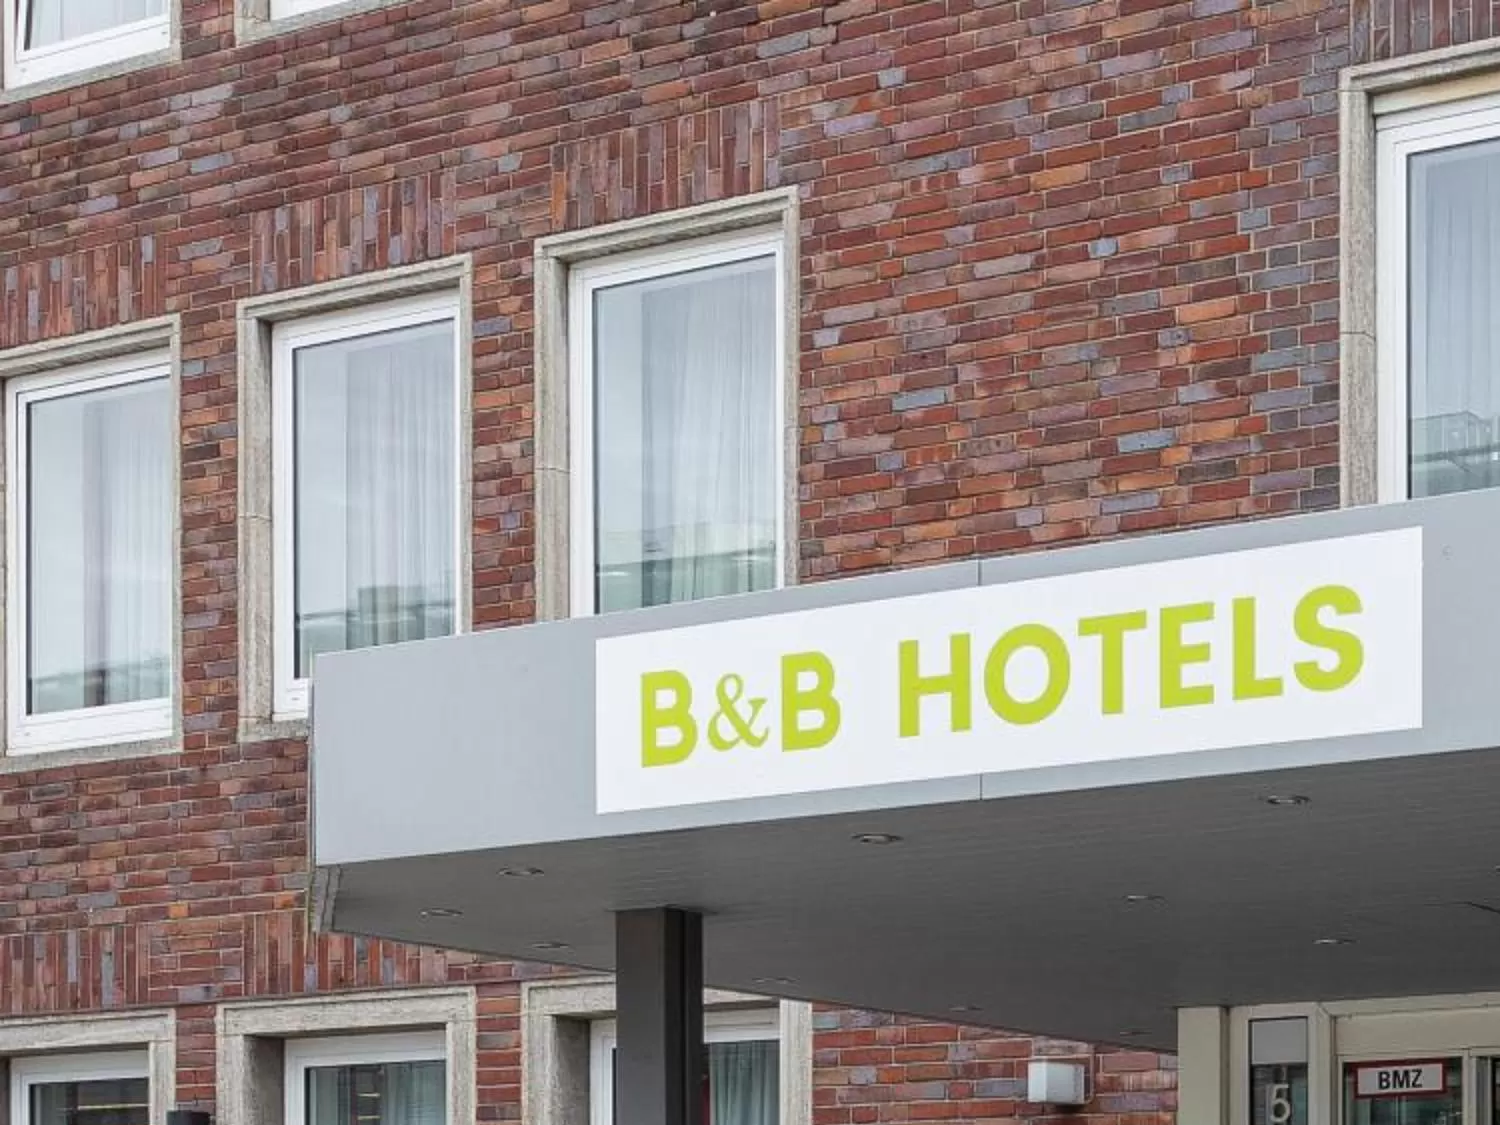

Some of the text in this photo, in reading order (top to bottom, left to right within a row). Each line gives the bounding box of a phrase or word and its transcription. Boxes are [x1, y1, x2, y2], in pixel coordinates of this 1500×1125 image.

[641, 585, 1364, 768] B&B HOTELS
[1377, 1068, 1422, 1090] BMZ
[1269, 1084, 1291, 1122] 5
